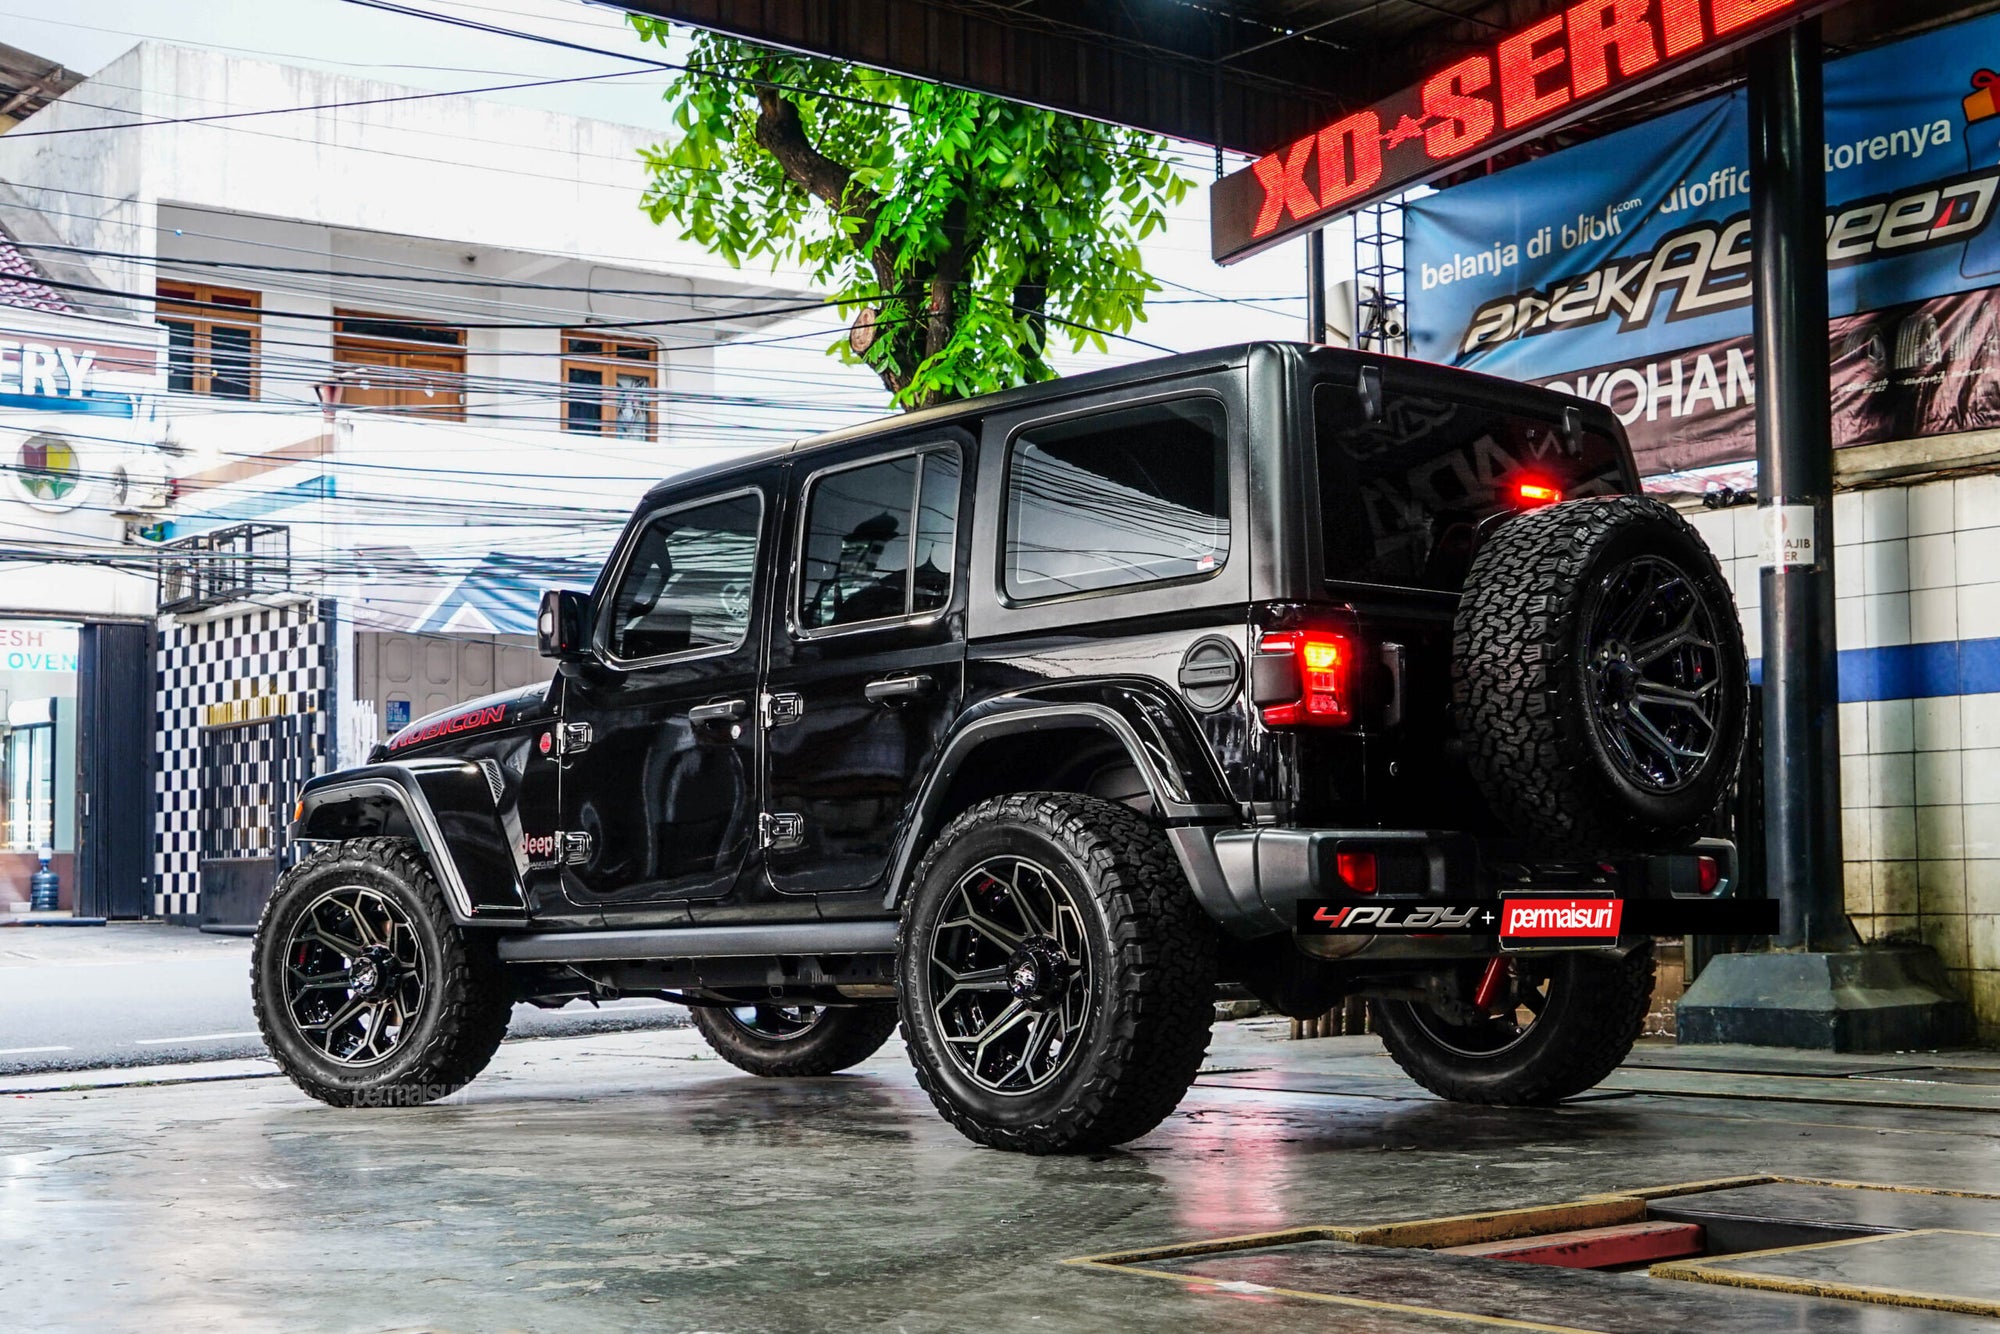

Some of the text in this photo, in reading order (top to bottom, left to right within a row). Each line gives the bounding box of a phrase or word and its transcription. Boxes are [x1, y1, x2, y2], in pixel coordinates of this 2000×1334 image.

[1252, 110, 1382, 238] XD
[1421, 242, 1519, 290] belanja
[1526, 226, 1552, 259] di
[1825, 118, 1952, 173] torenya
[8, 652, 77, 671] OVEN
[390, 703, 507, 751] RUBICON
[520, 832, 554, 857] Jeep
